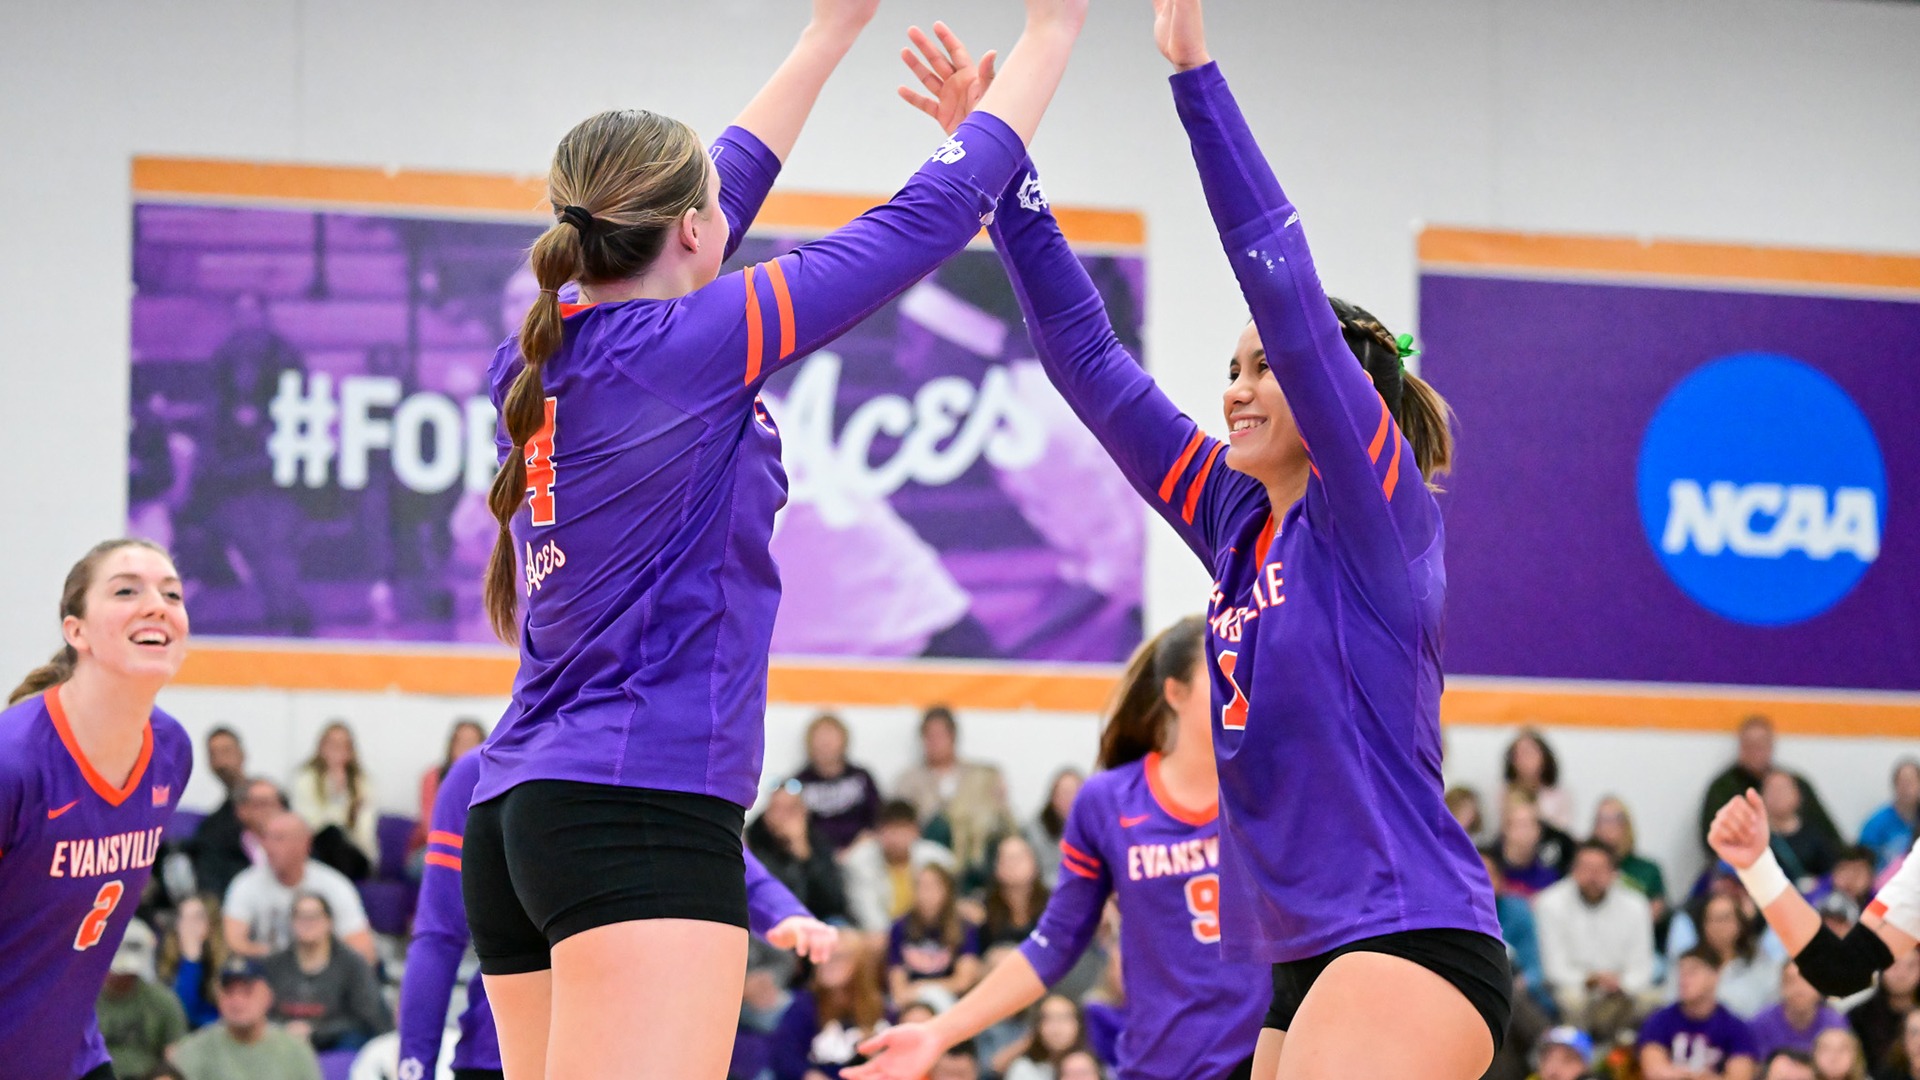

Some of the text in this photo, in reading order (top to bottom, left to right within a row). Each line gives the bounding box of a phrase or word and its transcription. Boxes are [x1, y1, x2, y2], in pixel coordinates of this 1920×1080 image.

[1663, 478, 1880, 563] NCAA
[525, 539, 566, 598] Aces
[49, 825, 163, 878] EVANSVILLE
[73, 879, 124, 951] 2
